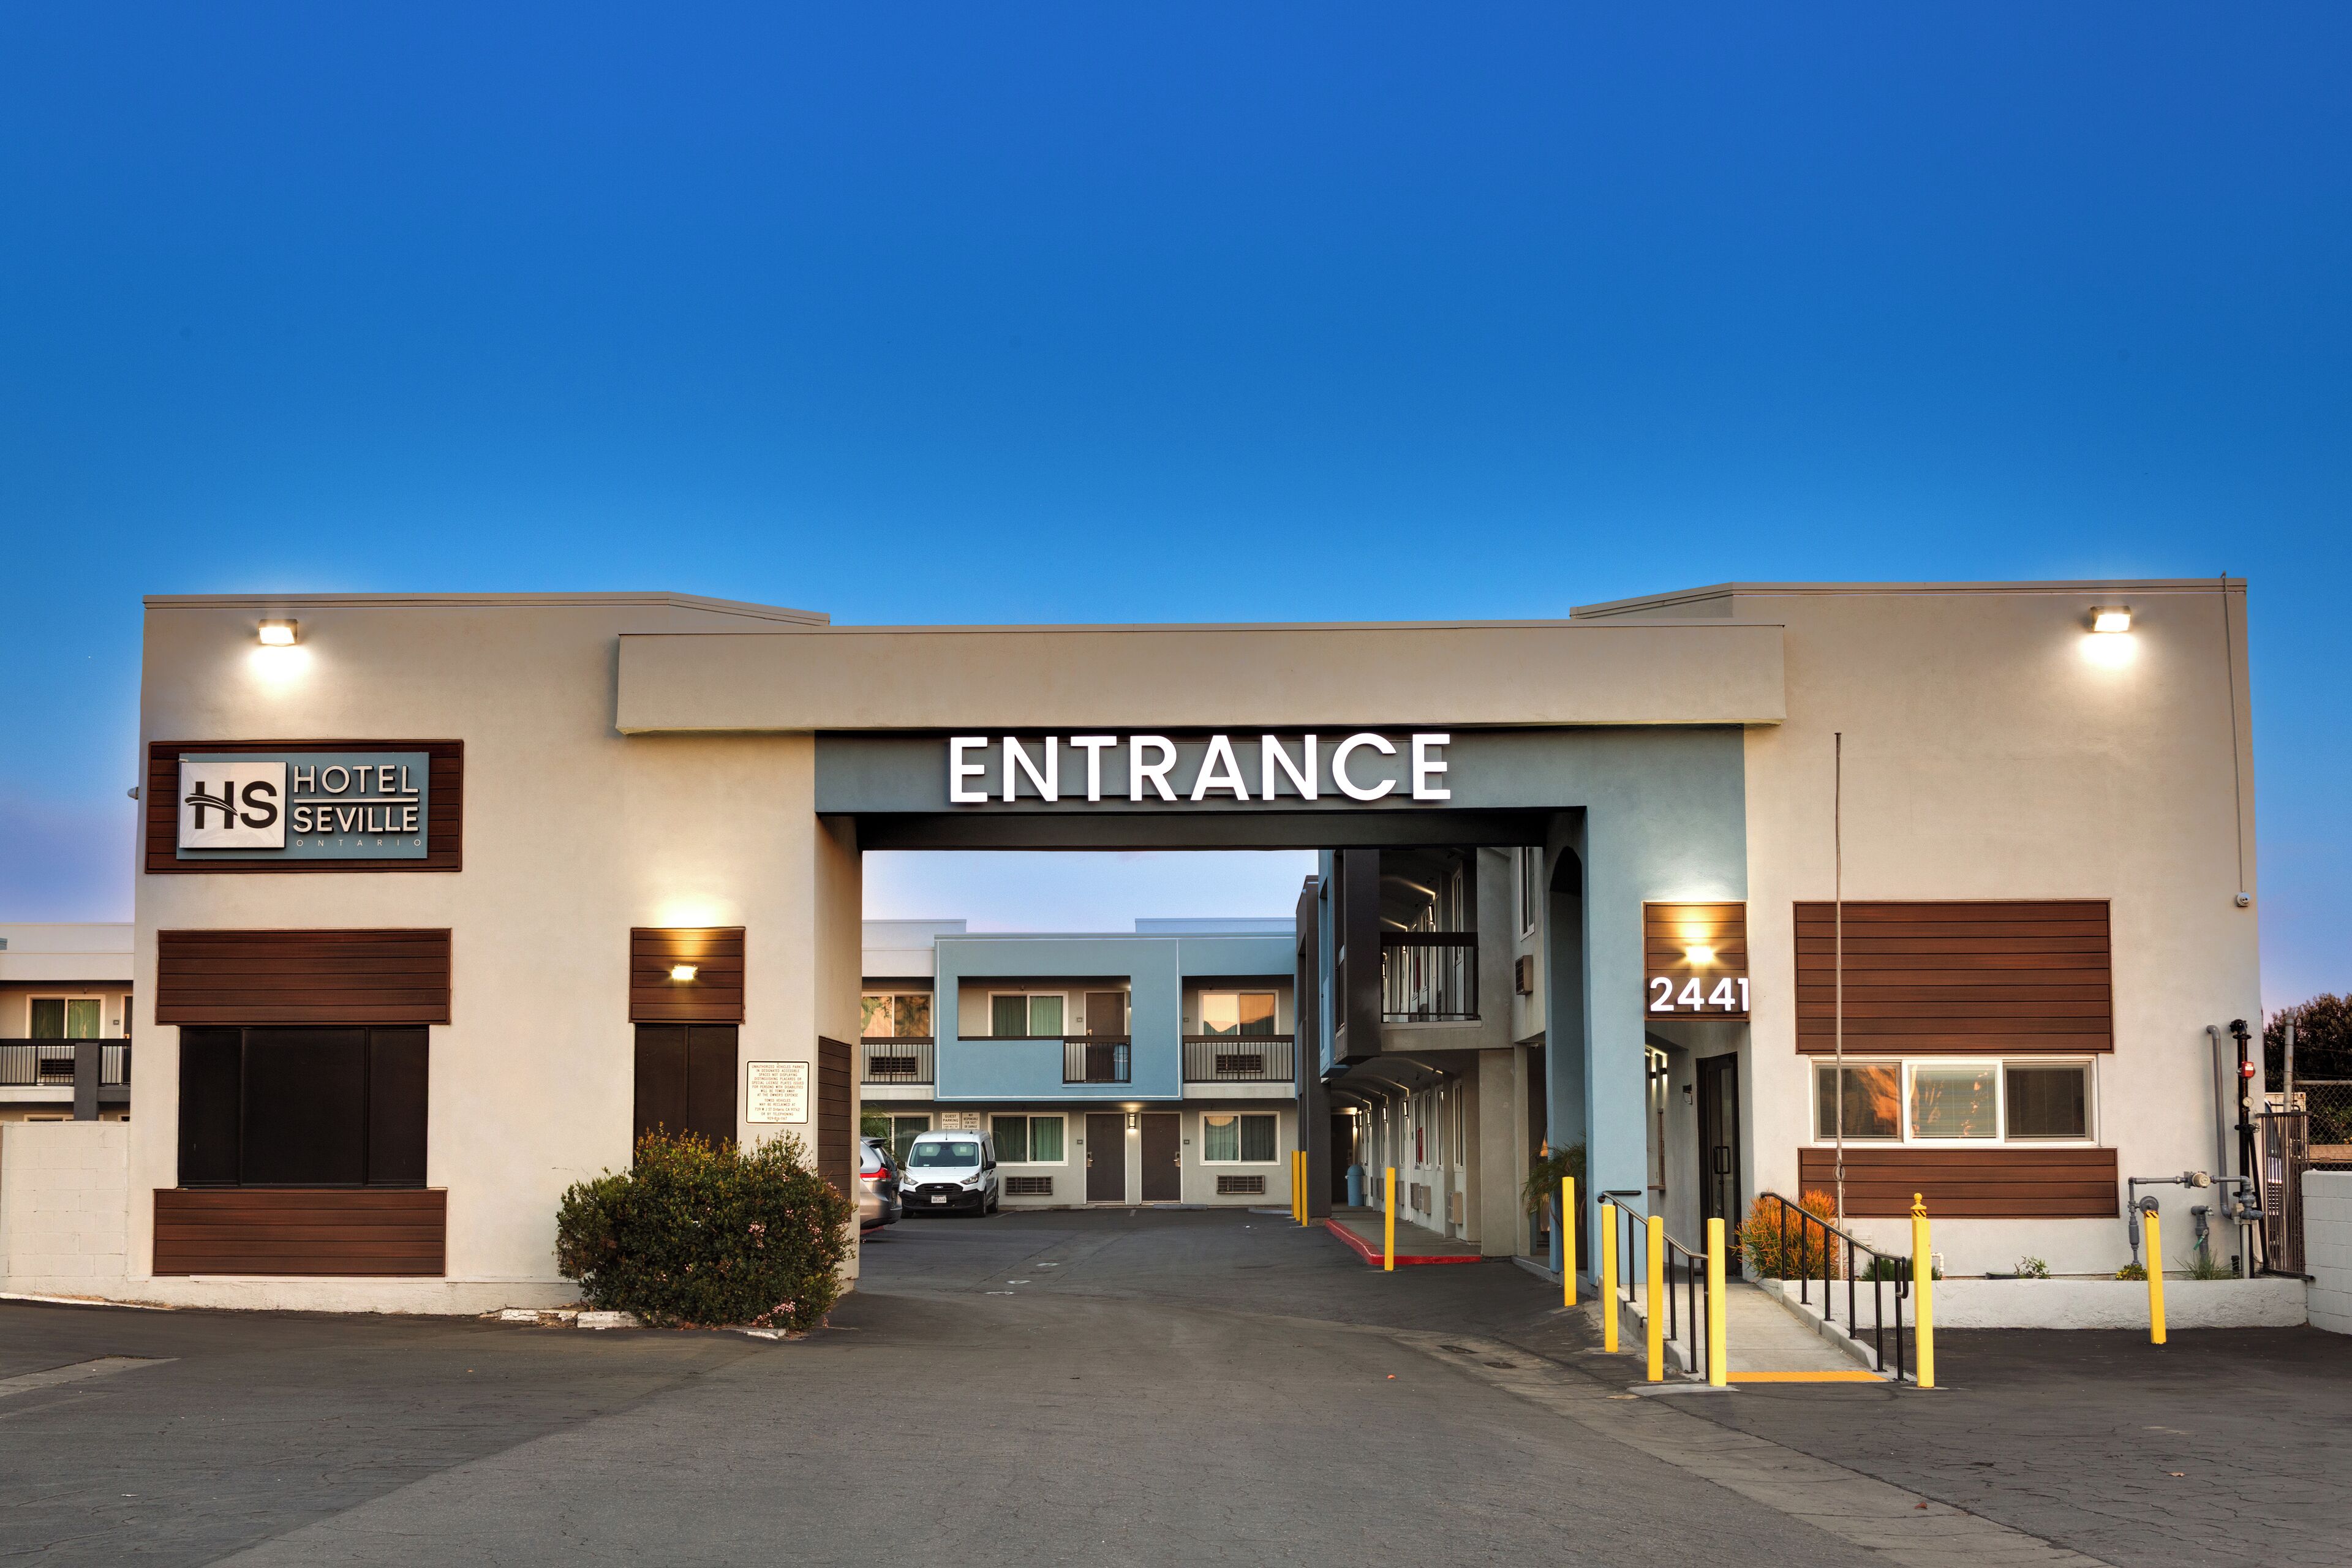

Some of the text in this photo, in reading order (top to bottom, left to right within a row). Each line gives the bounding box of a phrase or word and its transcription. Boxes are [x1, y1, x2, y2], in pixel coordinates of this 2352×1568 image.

[293, 764, 420, 794] HOTEL
[949, 733, 1452, 804] ENTRANCE
[185, 780, 278, 829] HS
[293, 806, 419, 833] SEVILLE
[1649, 977, 1750, 1012] 2441
